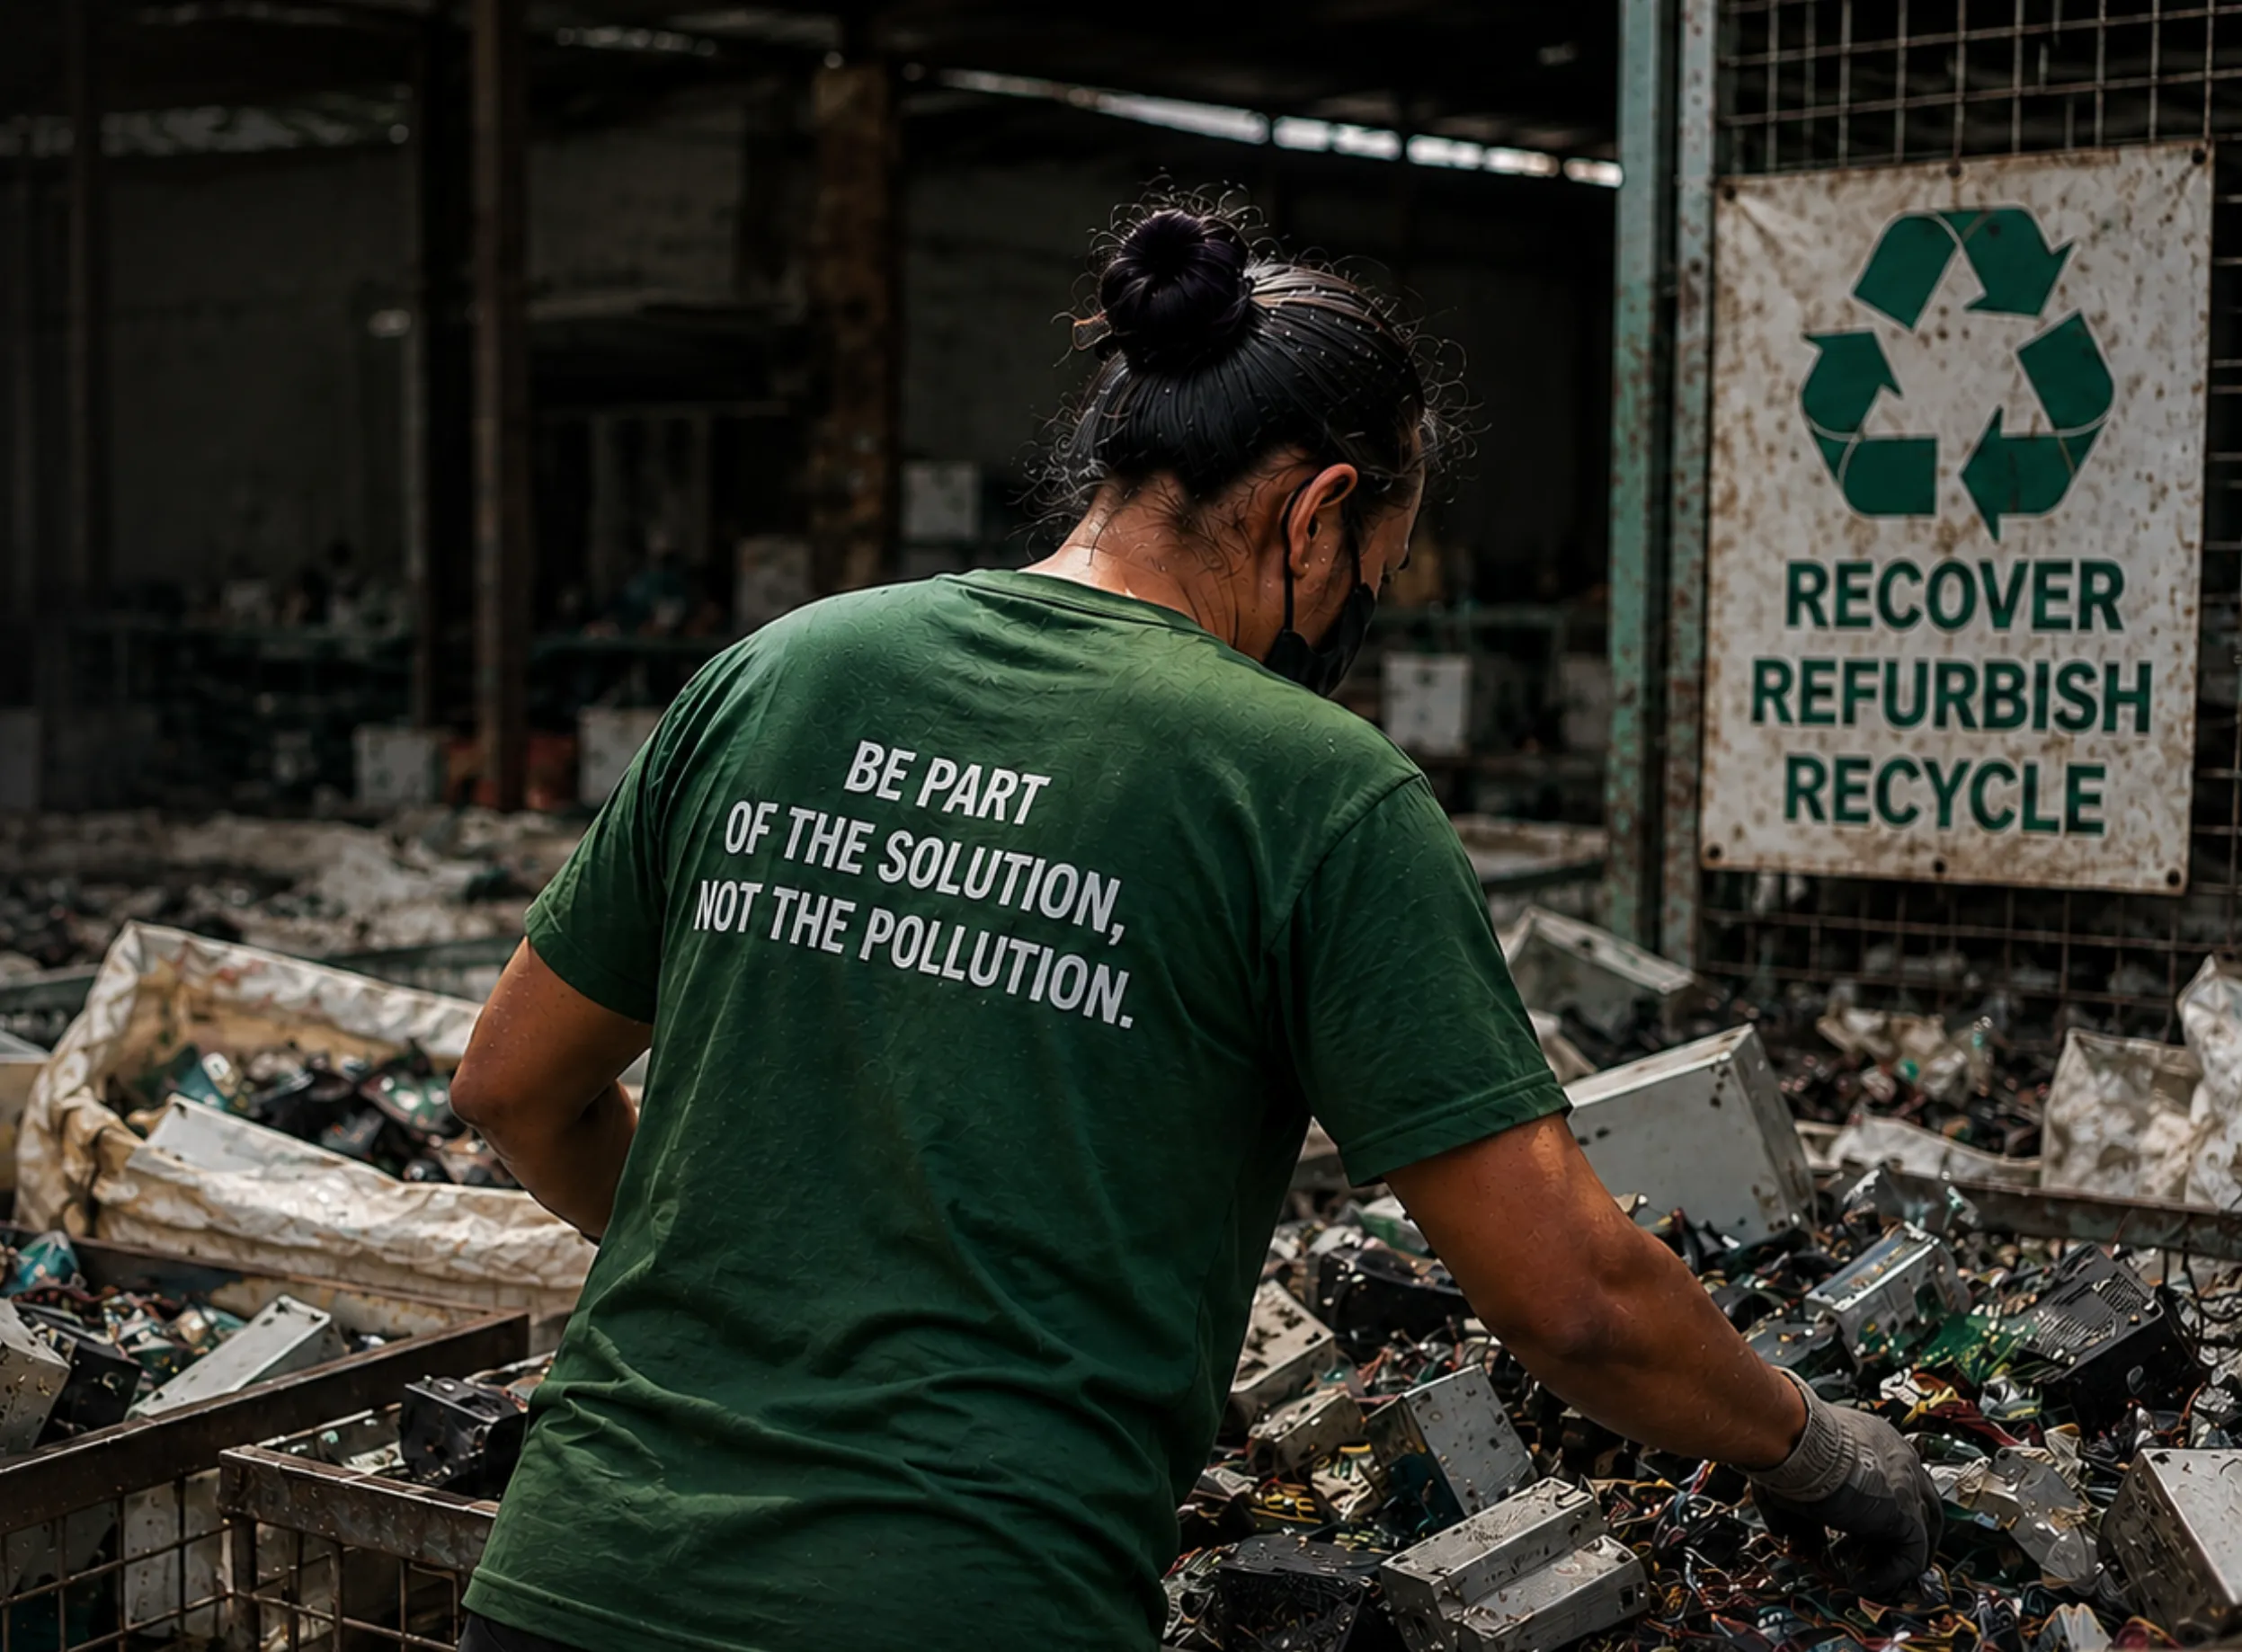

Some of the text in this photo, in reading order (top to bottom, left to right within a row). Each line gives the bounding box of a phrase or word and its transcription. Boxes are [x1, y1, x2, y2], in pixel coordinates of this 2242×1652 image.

[1785, 560, 2125, 631] RECOVER
[1751, 658, 2153, 733] REFURBISH
[843, 740, 1052, 826] BE PART
[1784, 755, 2107, 836] RECYCLE
[725, 801, 1125, 946] OF THE SOLUTION,
[693, 879, 1134, 1030] NOT THE POLLUTION.
